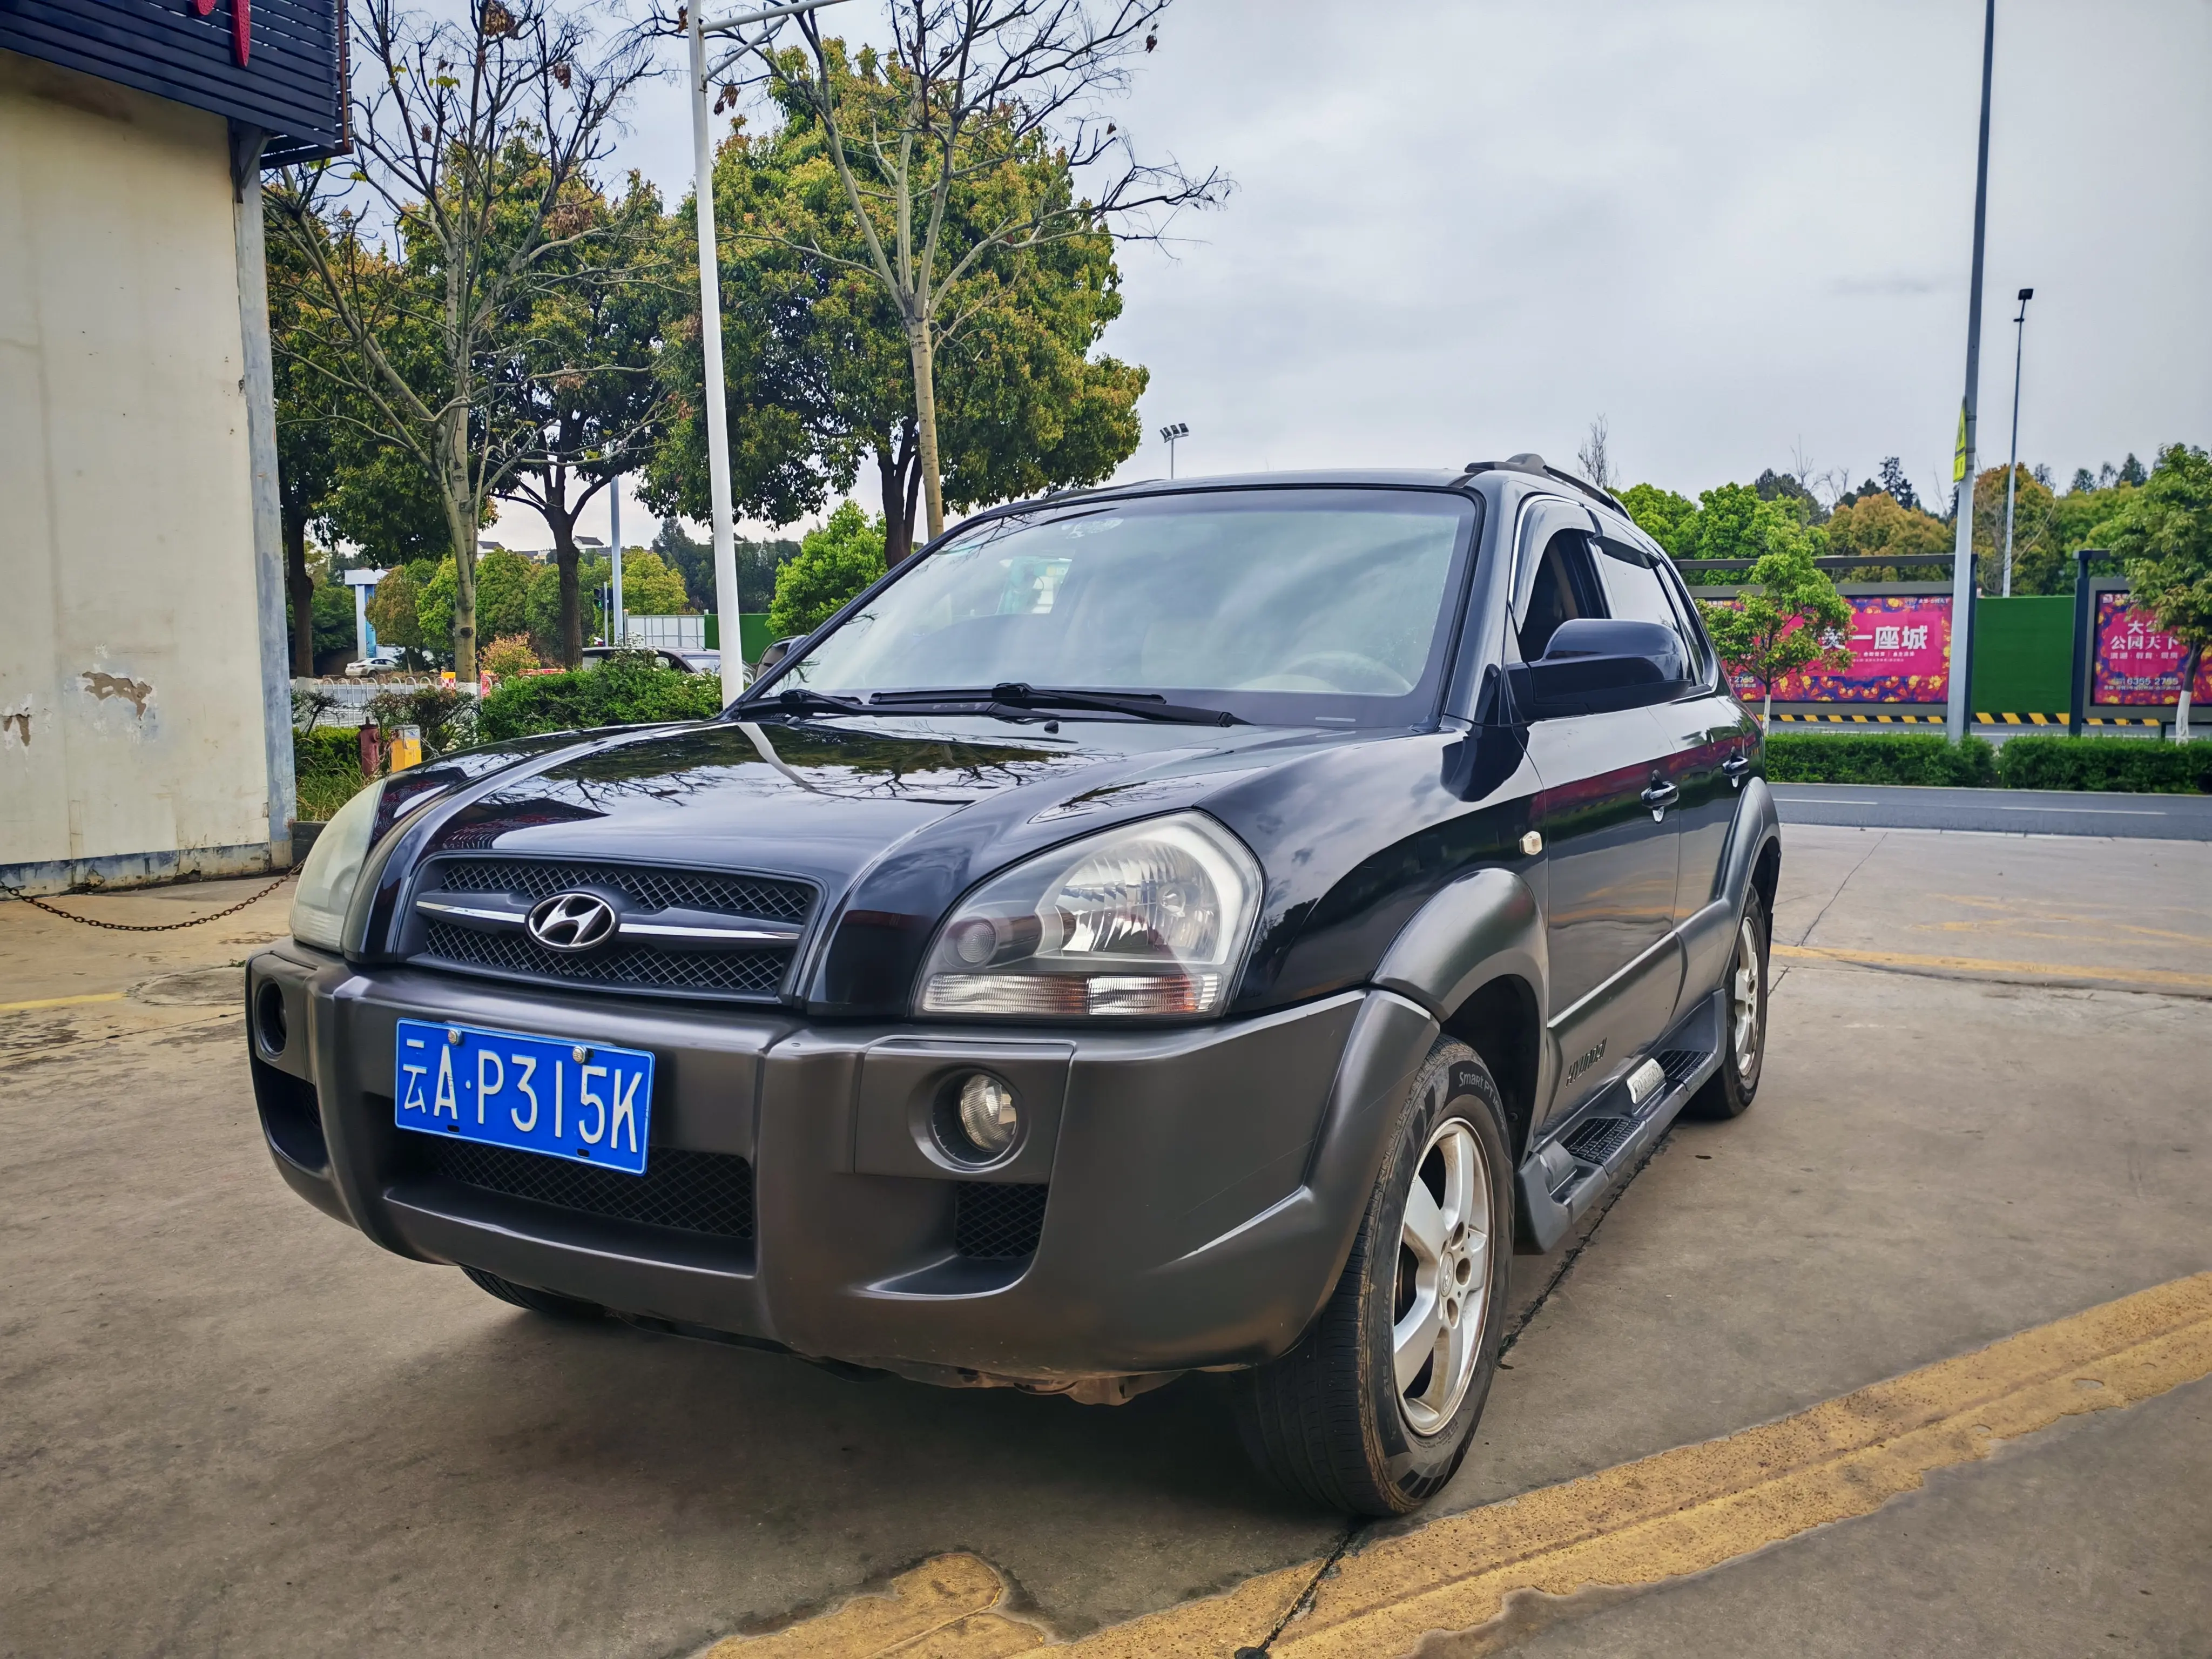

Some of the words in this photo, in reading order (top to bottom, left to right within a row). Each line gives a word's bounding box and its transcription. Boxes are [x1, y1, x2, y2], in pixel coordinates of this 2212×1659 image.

[2110, 635, 2180, 650] 公园天下
[1565, 1037, 1608, 1089] HYUNDAI
[402, 1037, 644, 1154] 云A·P315K
